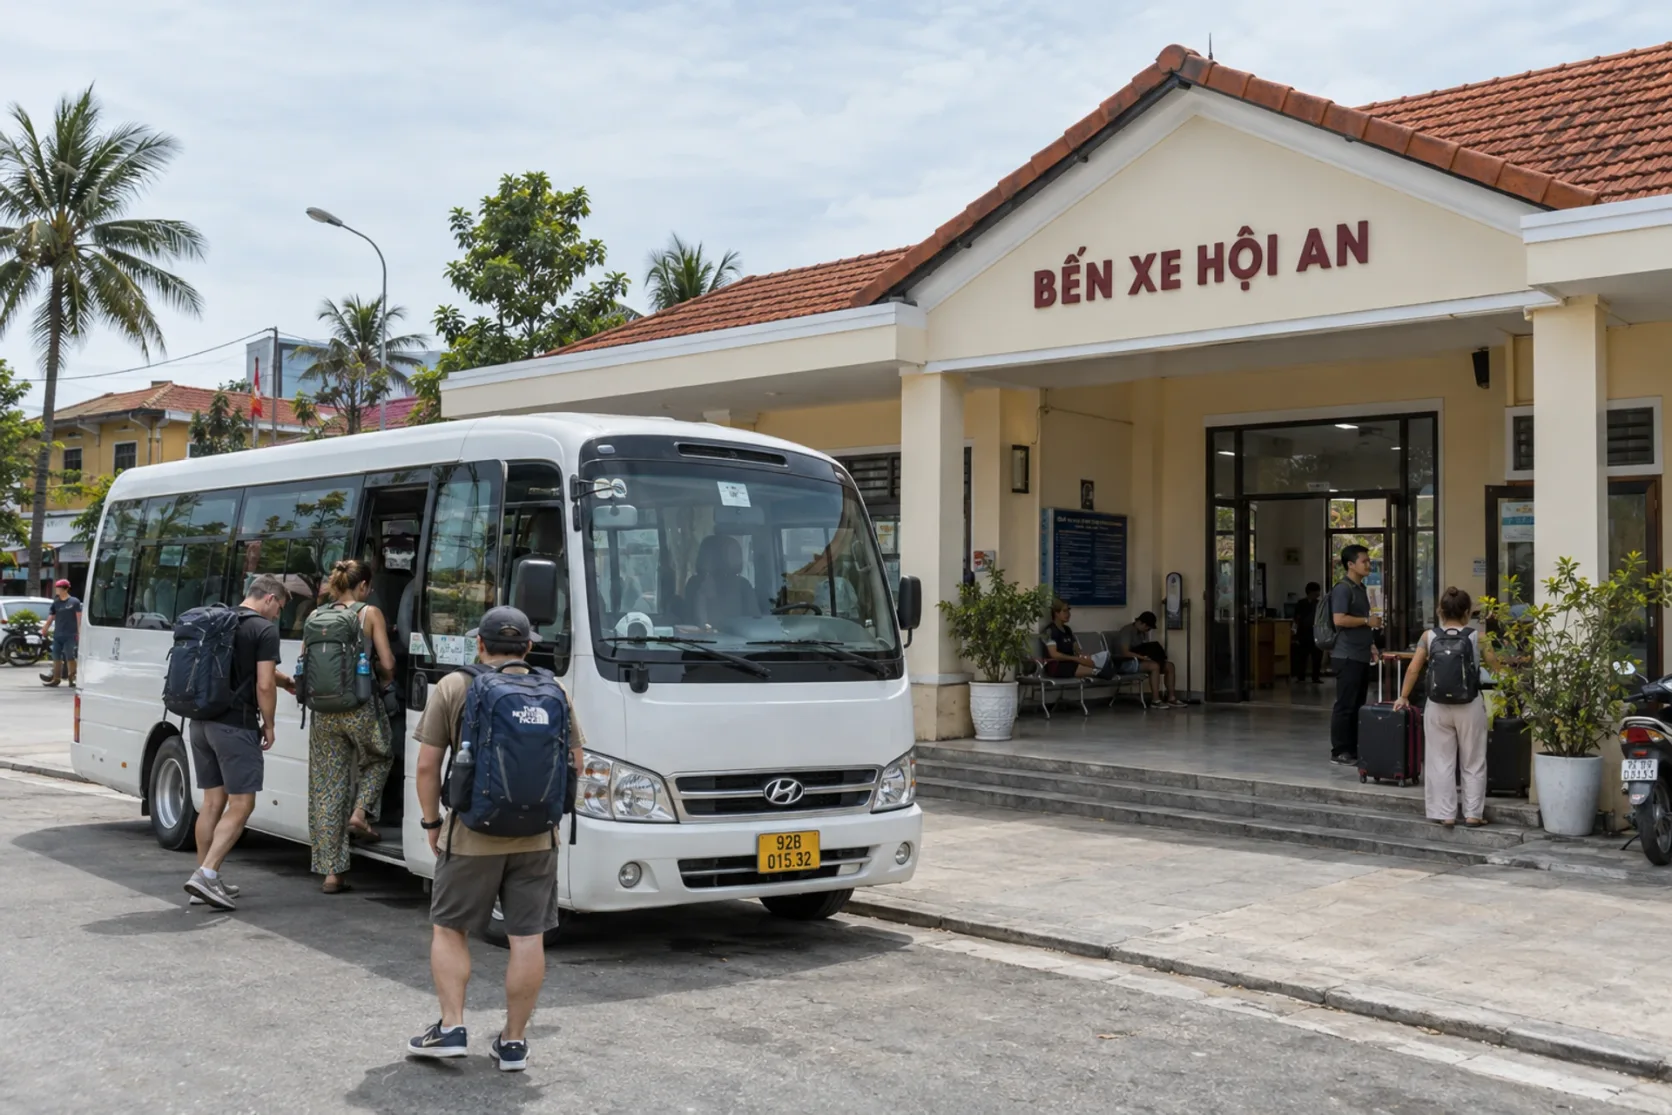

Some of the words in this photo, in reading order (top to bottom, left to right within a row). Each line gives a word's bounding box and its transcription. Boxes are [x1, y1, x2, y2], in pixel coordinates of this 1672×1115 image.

[1034, 246, 1113, 309] BẾN
[1128, 249, 1181, 295] XE
[1197, 225, 1278, 291] HỘI
[1296, 220, 1369, 272] AN
[776, 834, 802, 851] 92B
[767, 851, 812, 870] 015.32
